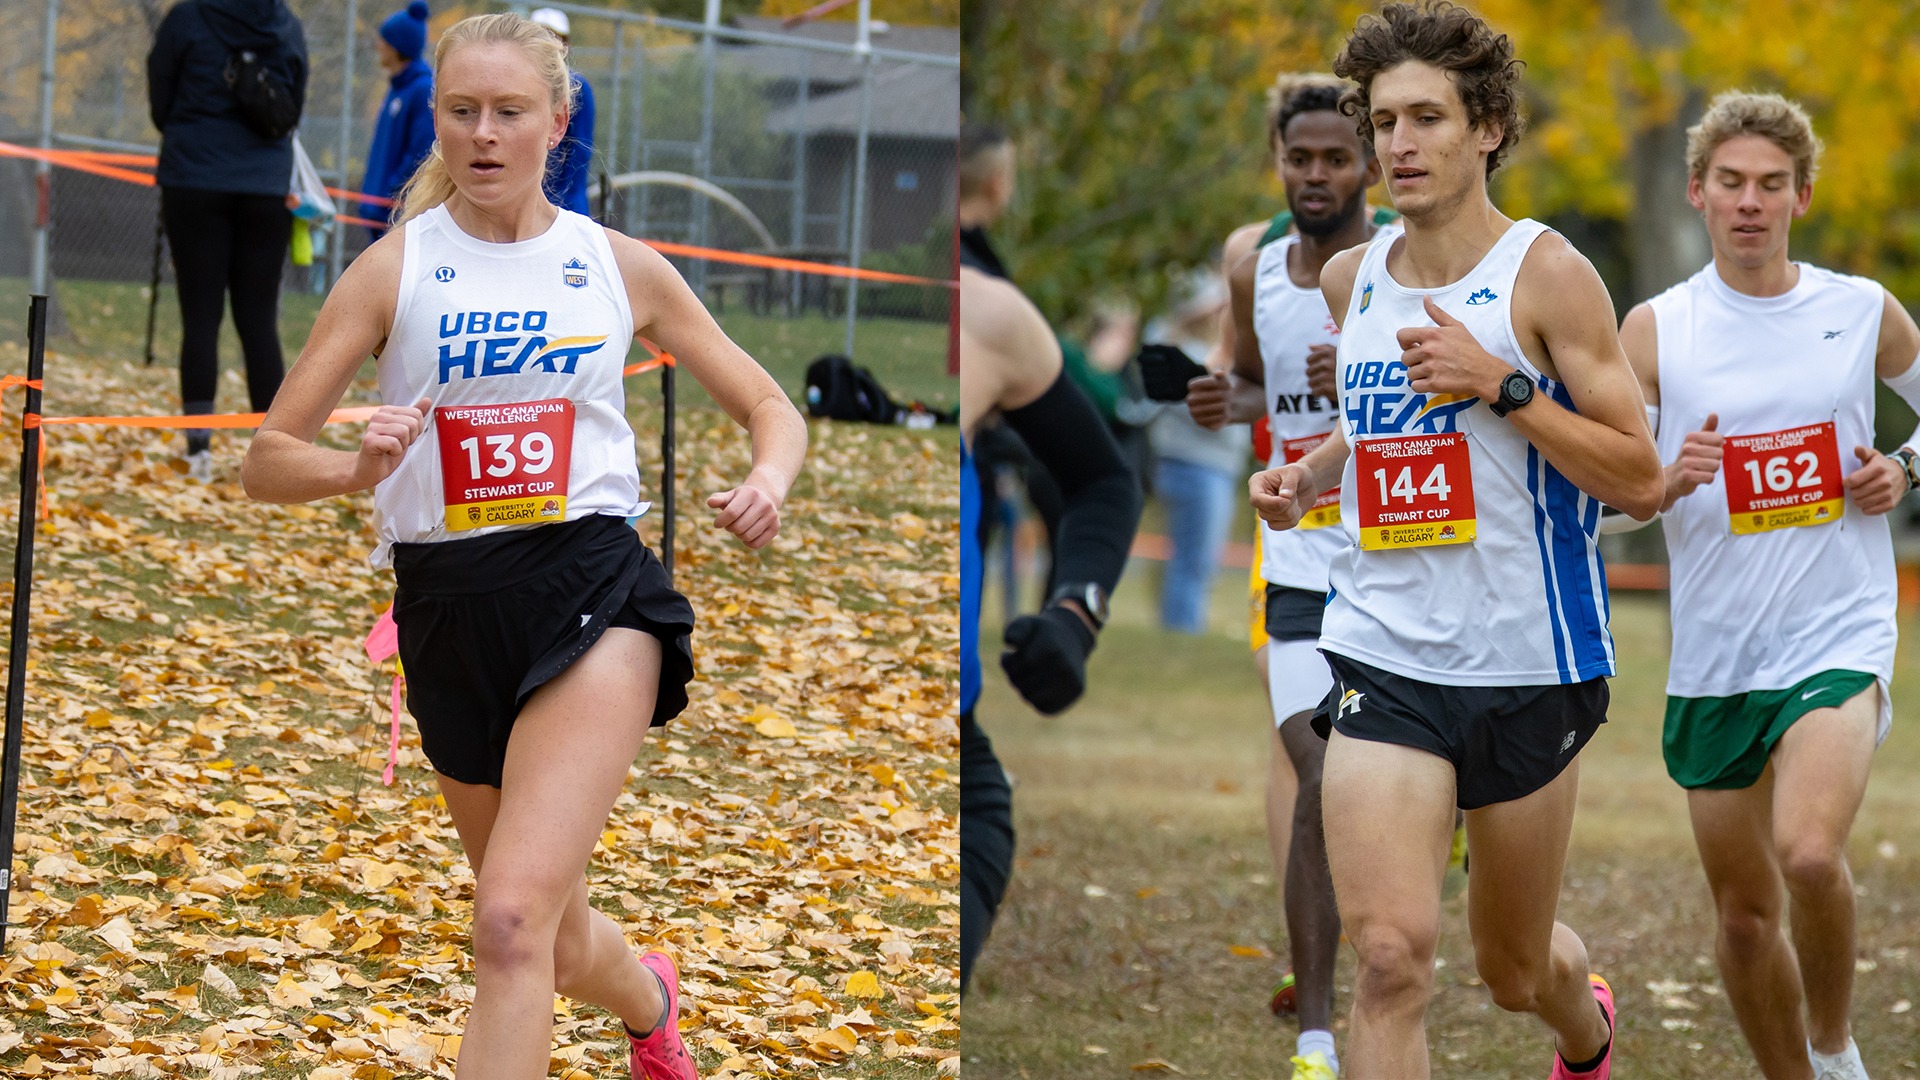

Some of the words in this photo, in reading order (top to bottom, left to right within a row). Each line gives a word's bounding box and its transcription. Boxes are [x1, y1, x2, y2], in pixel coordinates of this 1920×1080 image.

[567, 275, 587, 285] WEST
[439, 310, 548, 339] UBCO
[438, 334, 609, 385] HEAT
[1344, 361, 1414, 391] UBC
[445, 408, 500, 421] WESTERN
[502, 403, 564, 416] CANADIAN
[470, 412, 539, 427] CHALLENGE
[1344, 393, 1481, 437] HEAT
[1365, 442, 1402, 453] WESTERN
[1403, 437, 1455, 450] CANADIAN
[1732, 437, 1773, 447] WESTERN
[1775, 427, 1822, 441] CANADIAN
[1750, 438, 1804, 452] CHALLENGE
[459, 431, 555, 481] 139
[1381, 446, 1434, 459] CHALLENGE
[1744, 451, 1822, 494] 162
[464, 483, 524, 500] STEWART
[527, 481, 555, 493] CUP
[1373, 463, 1452, 507] 144
[485, 502, 525, 513] UNIVERSITY
[526, 501, 536, 509] OF
[1749, 495, 1799, 510] STEWART
[1802, 490, 1823, 502] CUP
[486, 508, 537, 523] CALGARY
[1378, 510, 1424, 524] STEWART
[1426, 508, 1451, 520] CUP
[1768, 515, 1811, 527] CALGARY
[1393, 533, 1435, 544] CALGARY
